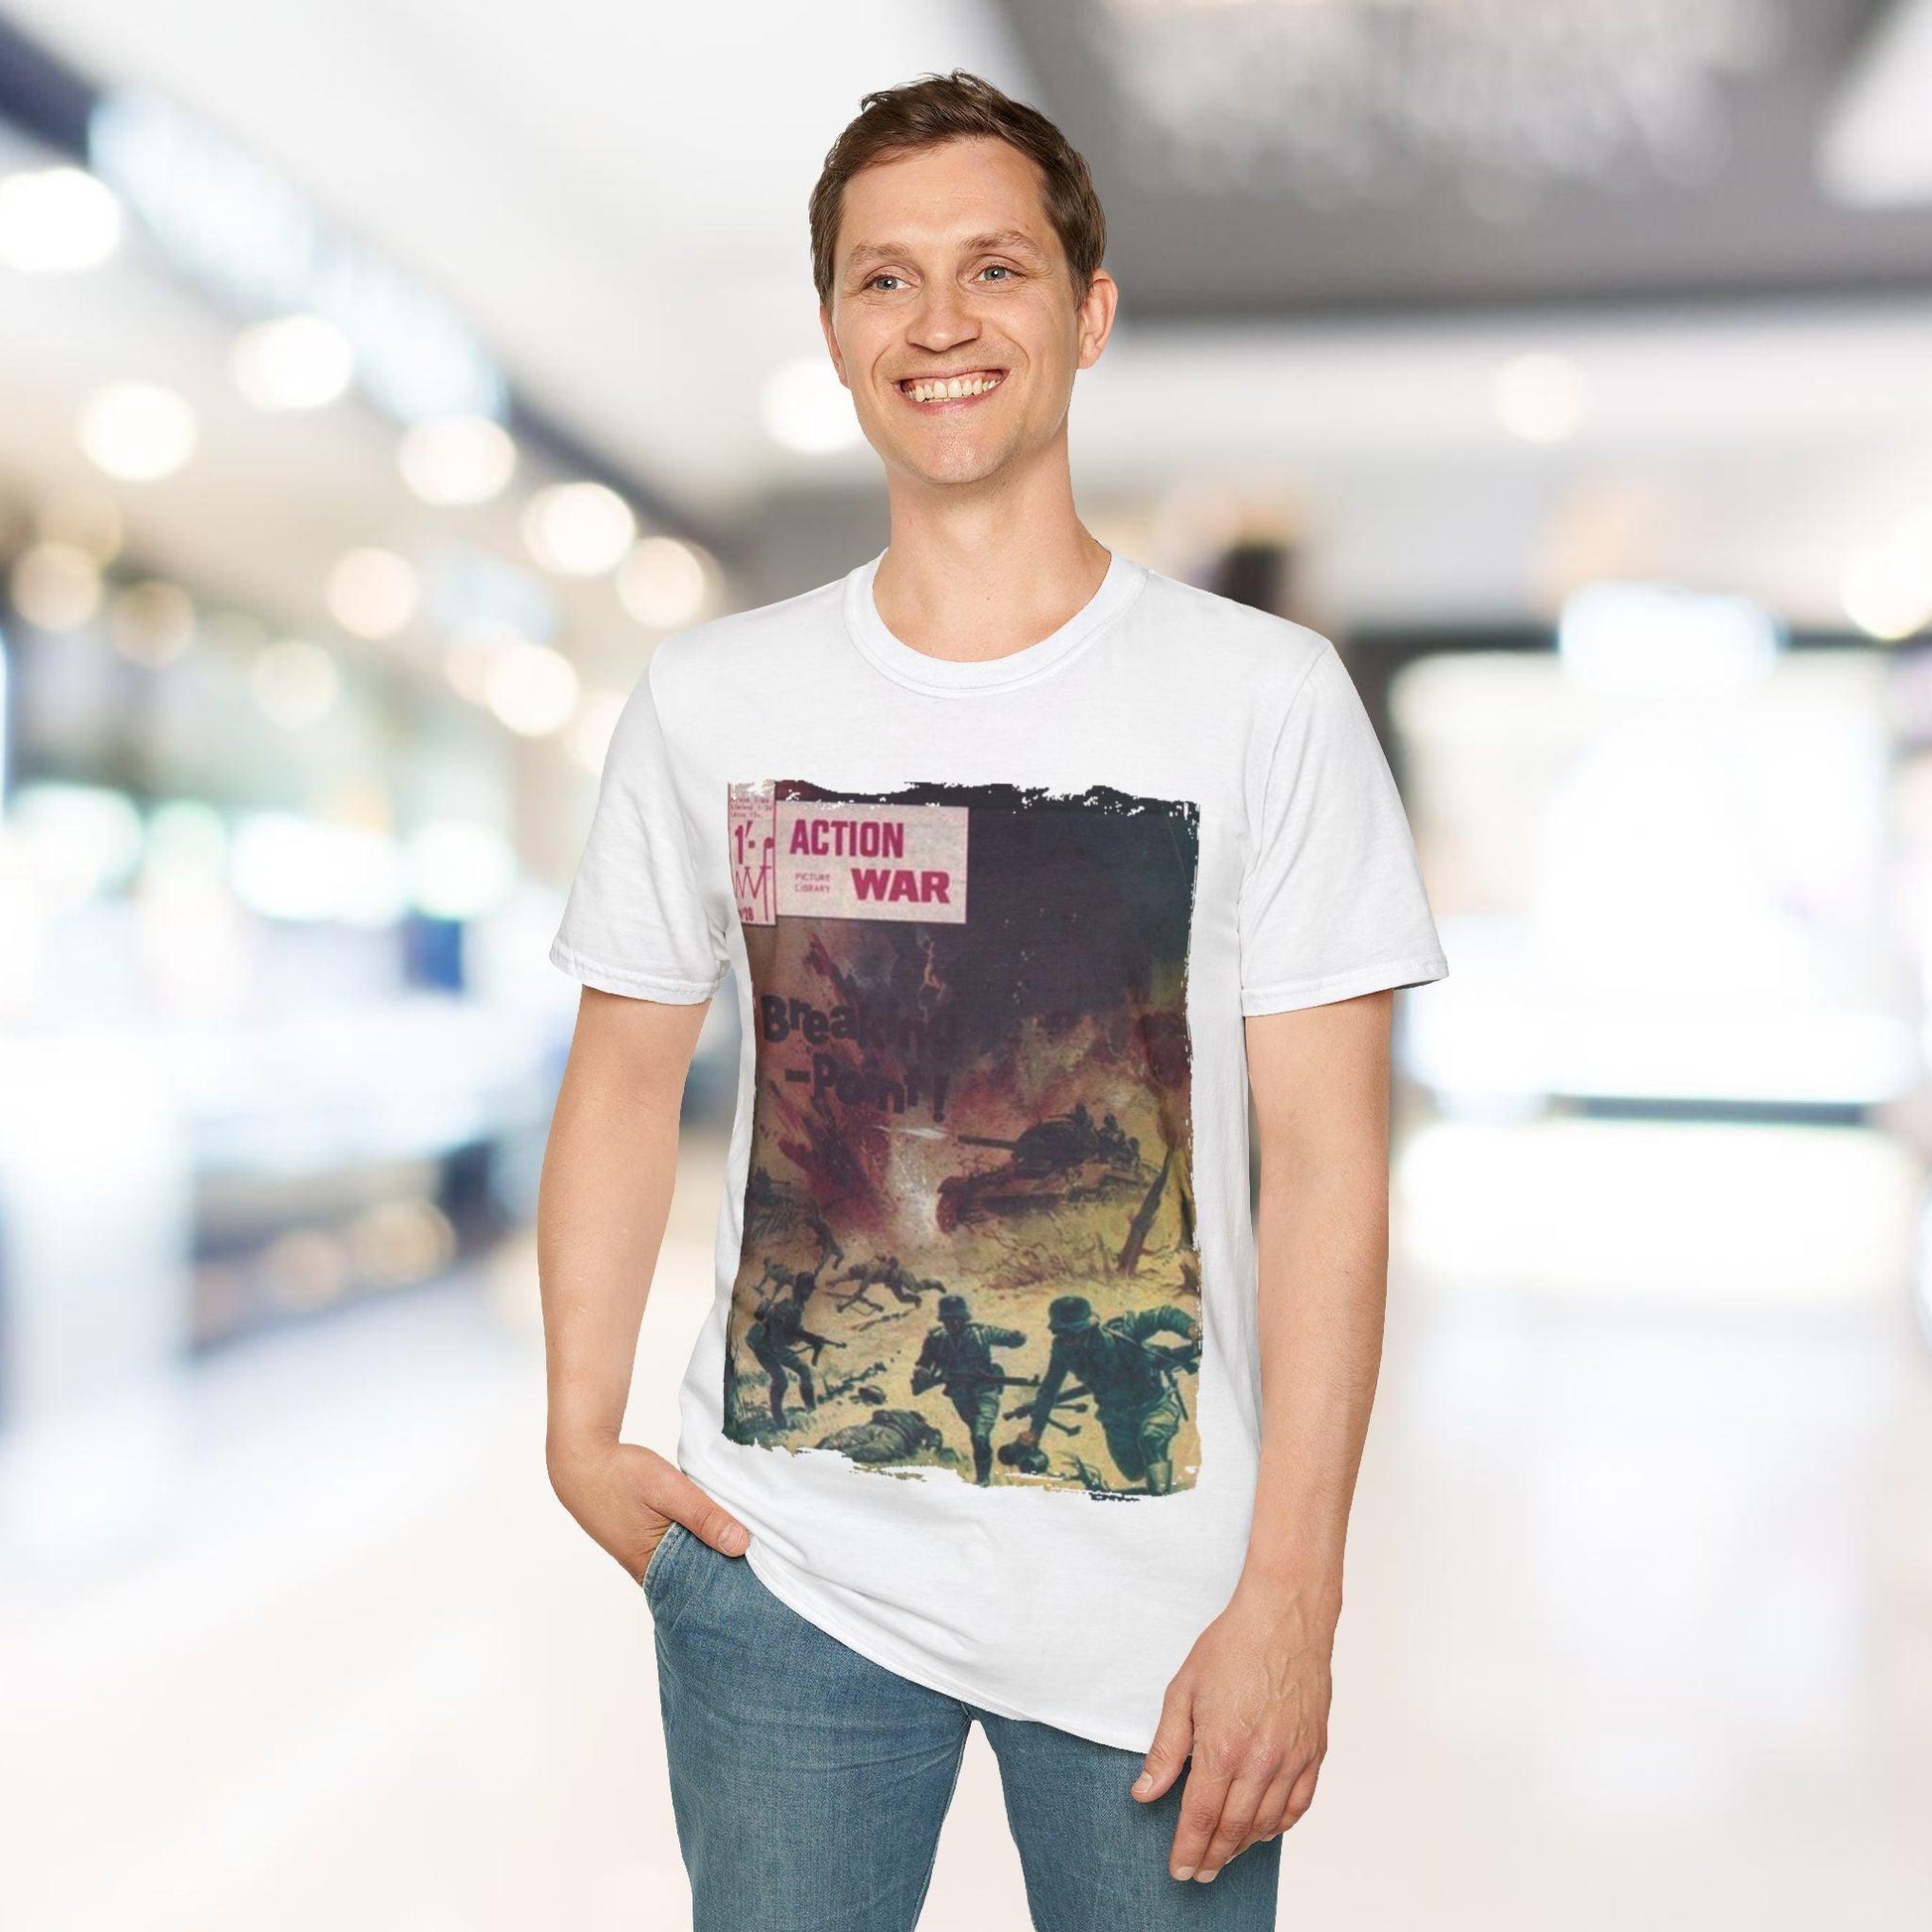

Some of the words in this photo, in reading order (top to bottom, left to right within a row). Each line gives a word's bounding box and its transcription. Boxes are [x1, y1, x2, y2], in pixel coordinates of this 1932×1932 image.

[789, 819, 904, 859] ACTION
[795, 873, 830, 882] PICTURE
[795, 884, 830, 893] LIBRARY
[851, 868, 950, 903] WAR
